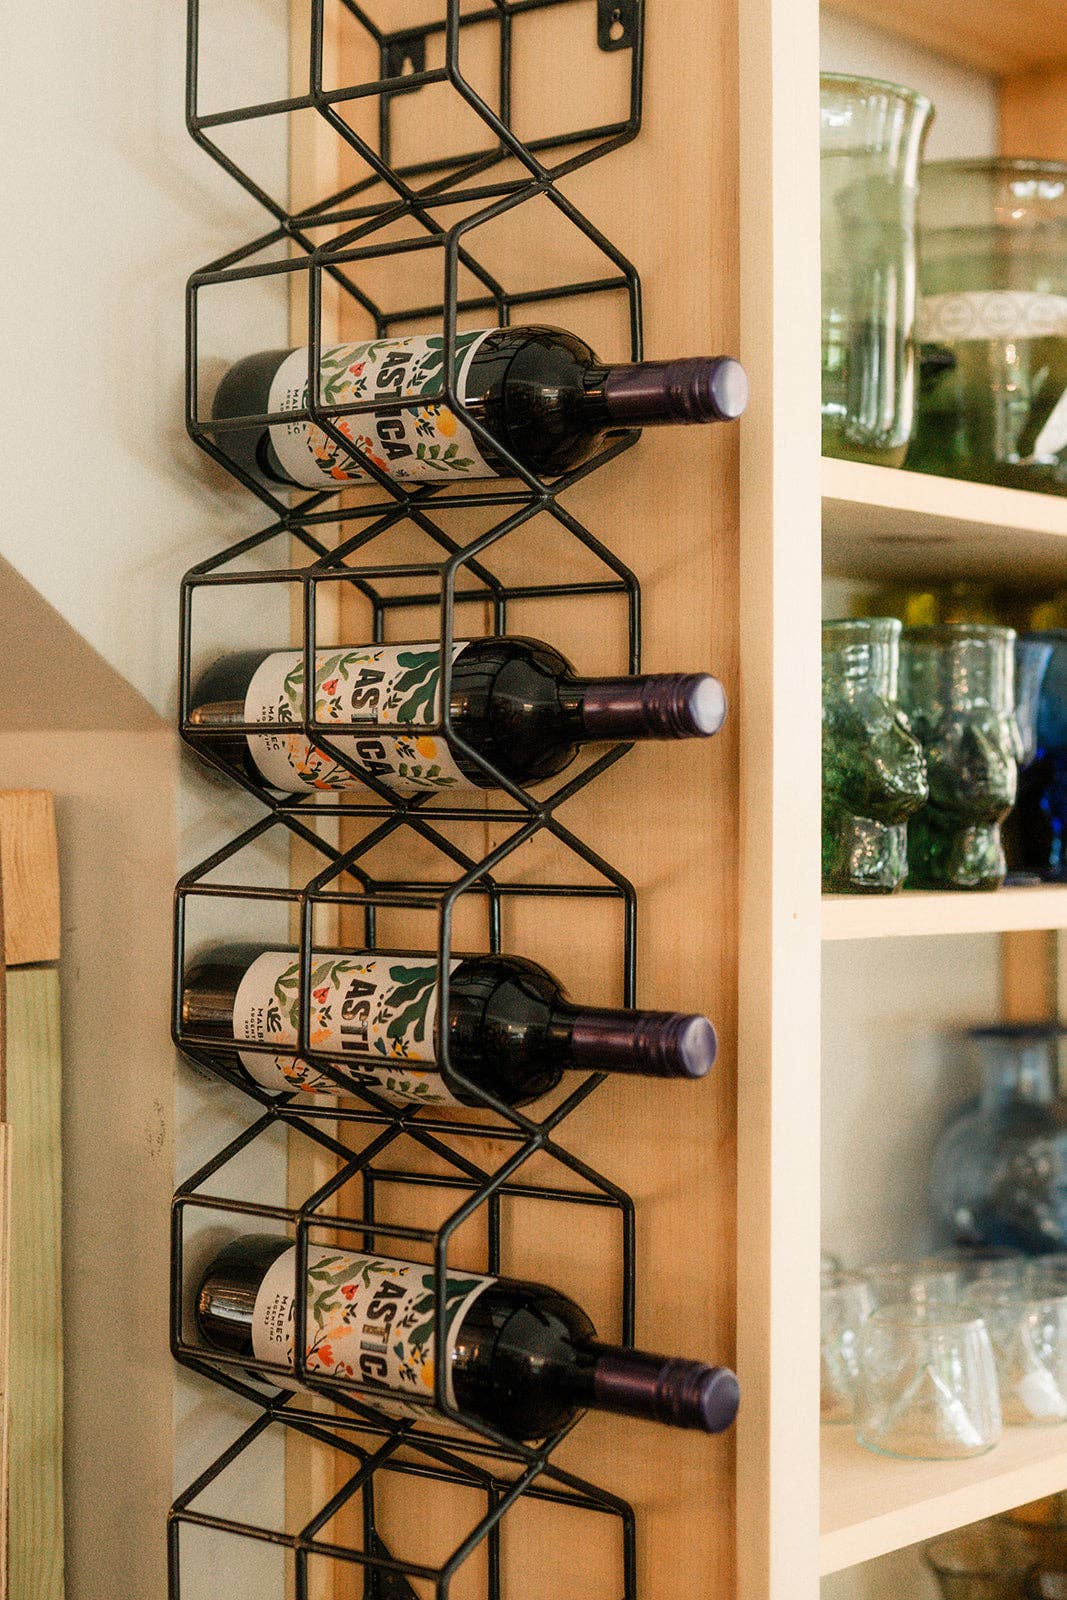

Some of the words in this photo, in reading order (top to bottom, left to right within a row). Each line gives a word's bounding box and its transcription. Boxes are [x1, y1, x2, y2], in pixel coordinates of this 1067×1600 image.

[292, 388, 300, 433] MALC
[375, 351, 414, 461] ASTICA
[268, 706, 280, 750] MAEC
[269, 1294, 280, 1341] ARGENTINA
[276, 1295, 288, 1343] MALBEC
